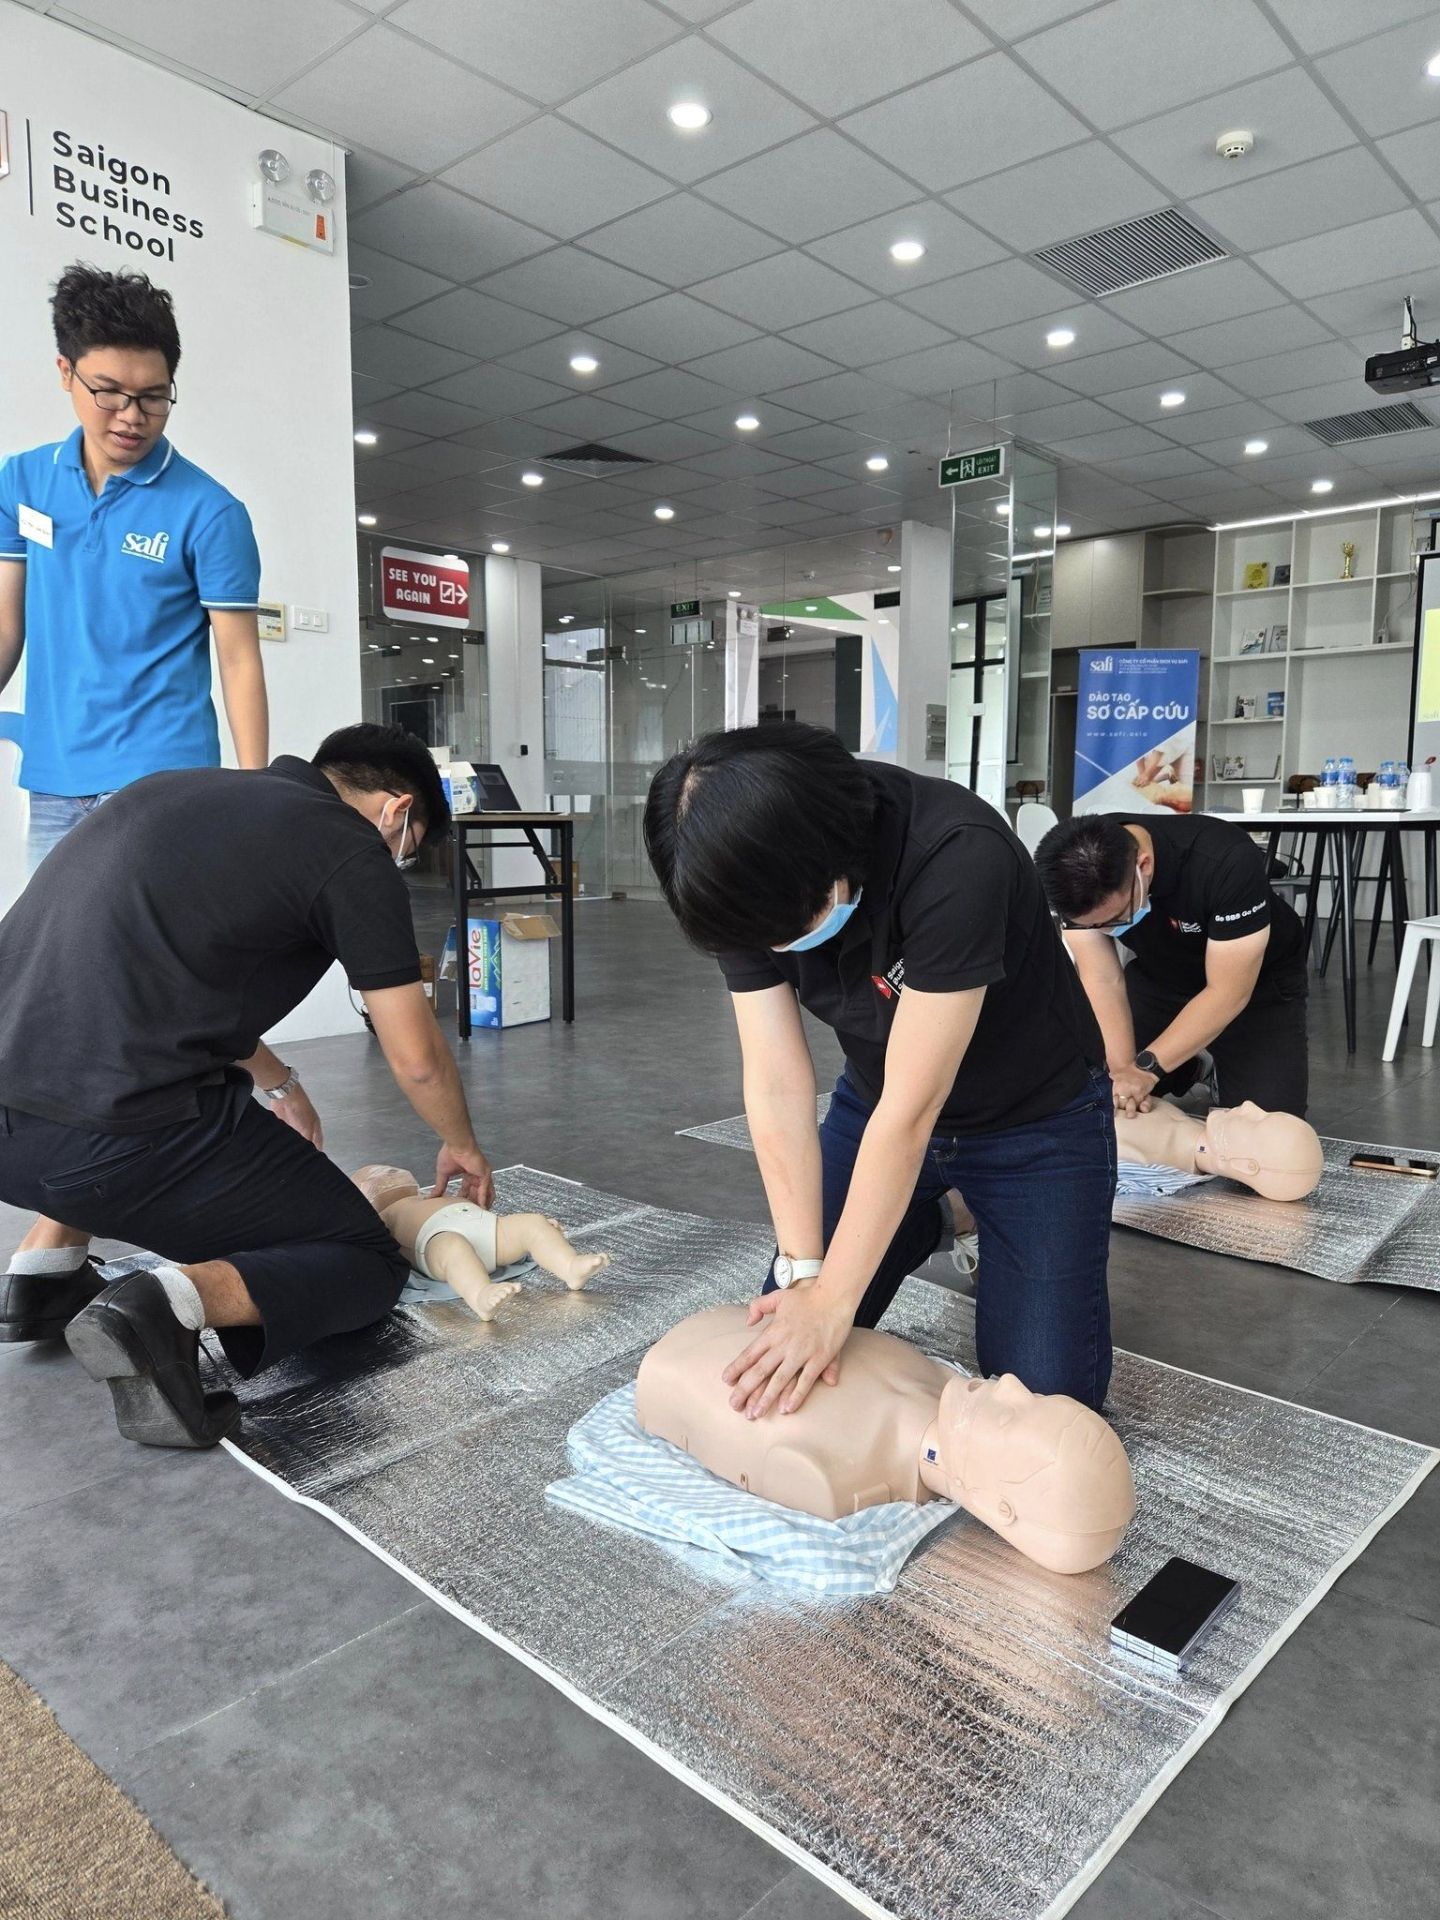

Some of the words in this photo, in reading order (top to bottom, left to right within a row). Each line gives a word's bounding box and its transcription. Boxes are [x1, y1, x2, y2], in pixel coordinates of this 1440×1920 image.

[52, 129, 171, 195] Saigon
[53, 164, 204, 239] Business
[56, 201, 175, 262] School
[977, 464, 995, 474] EXIT
[122, 531, 170, 560] safi
[388, 567, 408, 582] SEE
[412, 571, 437, 587] YOU
[396, 588, 431, 605] AGAIN
[676, 602, 694, 612] EXIT
[1089, 655, 1113, 672] safi
[1088, 691, 1110, 702] ĐÀO
[1111, 693, 1131, 704] TẠO
[1086, 703, 1110, 720] SƠ
[1113, 699, 1149, 720] CẤP
[1152, 701, 1189, 720] CỨU
